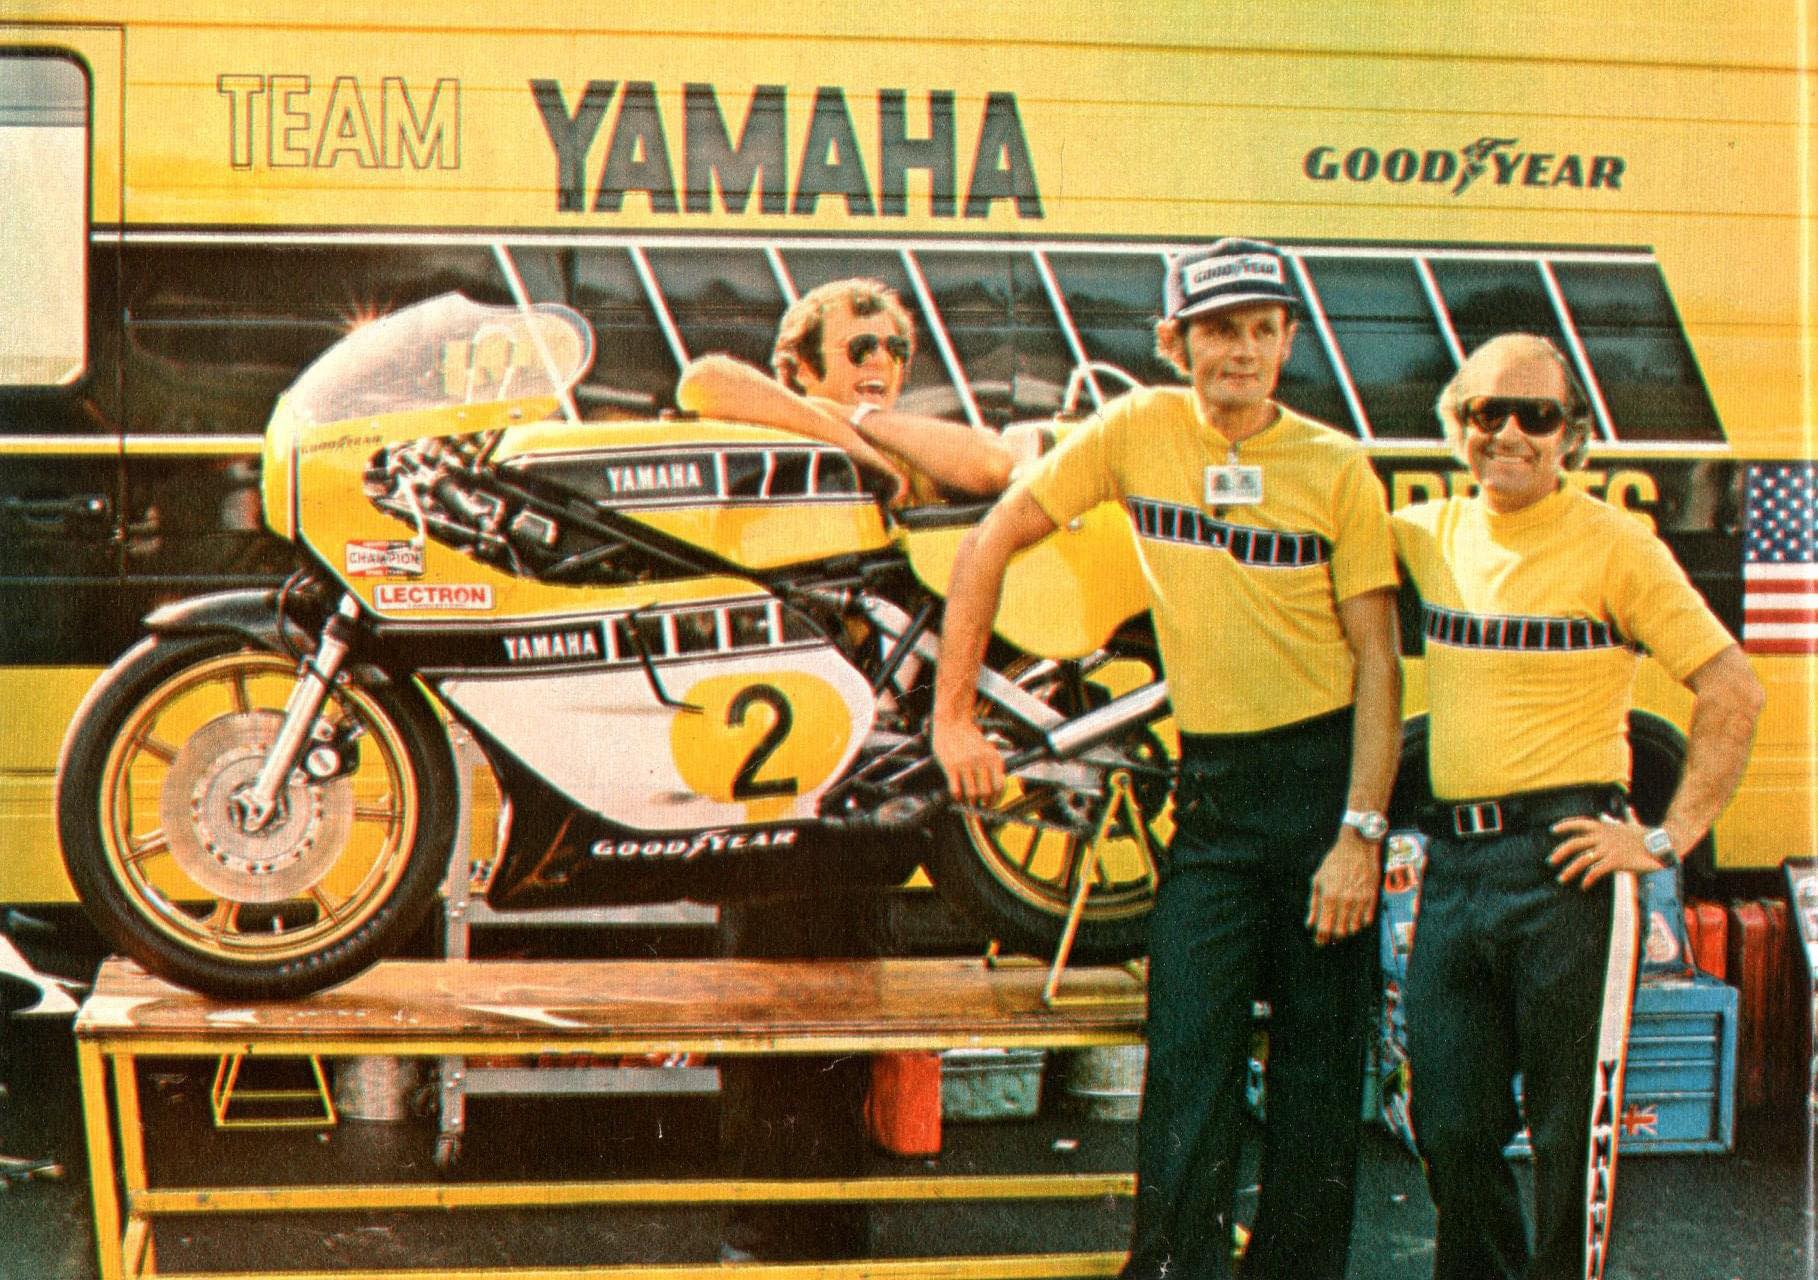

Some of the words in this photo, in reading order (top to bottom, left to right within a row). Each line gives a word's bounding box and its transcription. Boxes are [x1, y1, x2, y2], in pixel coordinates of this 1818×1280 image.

[217, 74, 461, 170] TEAM
[528, 79, 1046, 220] YAMAHA
[605, 462, 703, 493] YAMAHA
[350, 550, 421, 564] CHAMPION
[380, 586, 486, 603] LECTRON
[503, 630, 599, 661] YAMAHA
[726, 684, 799, 801] 2
